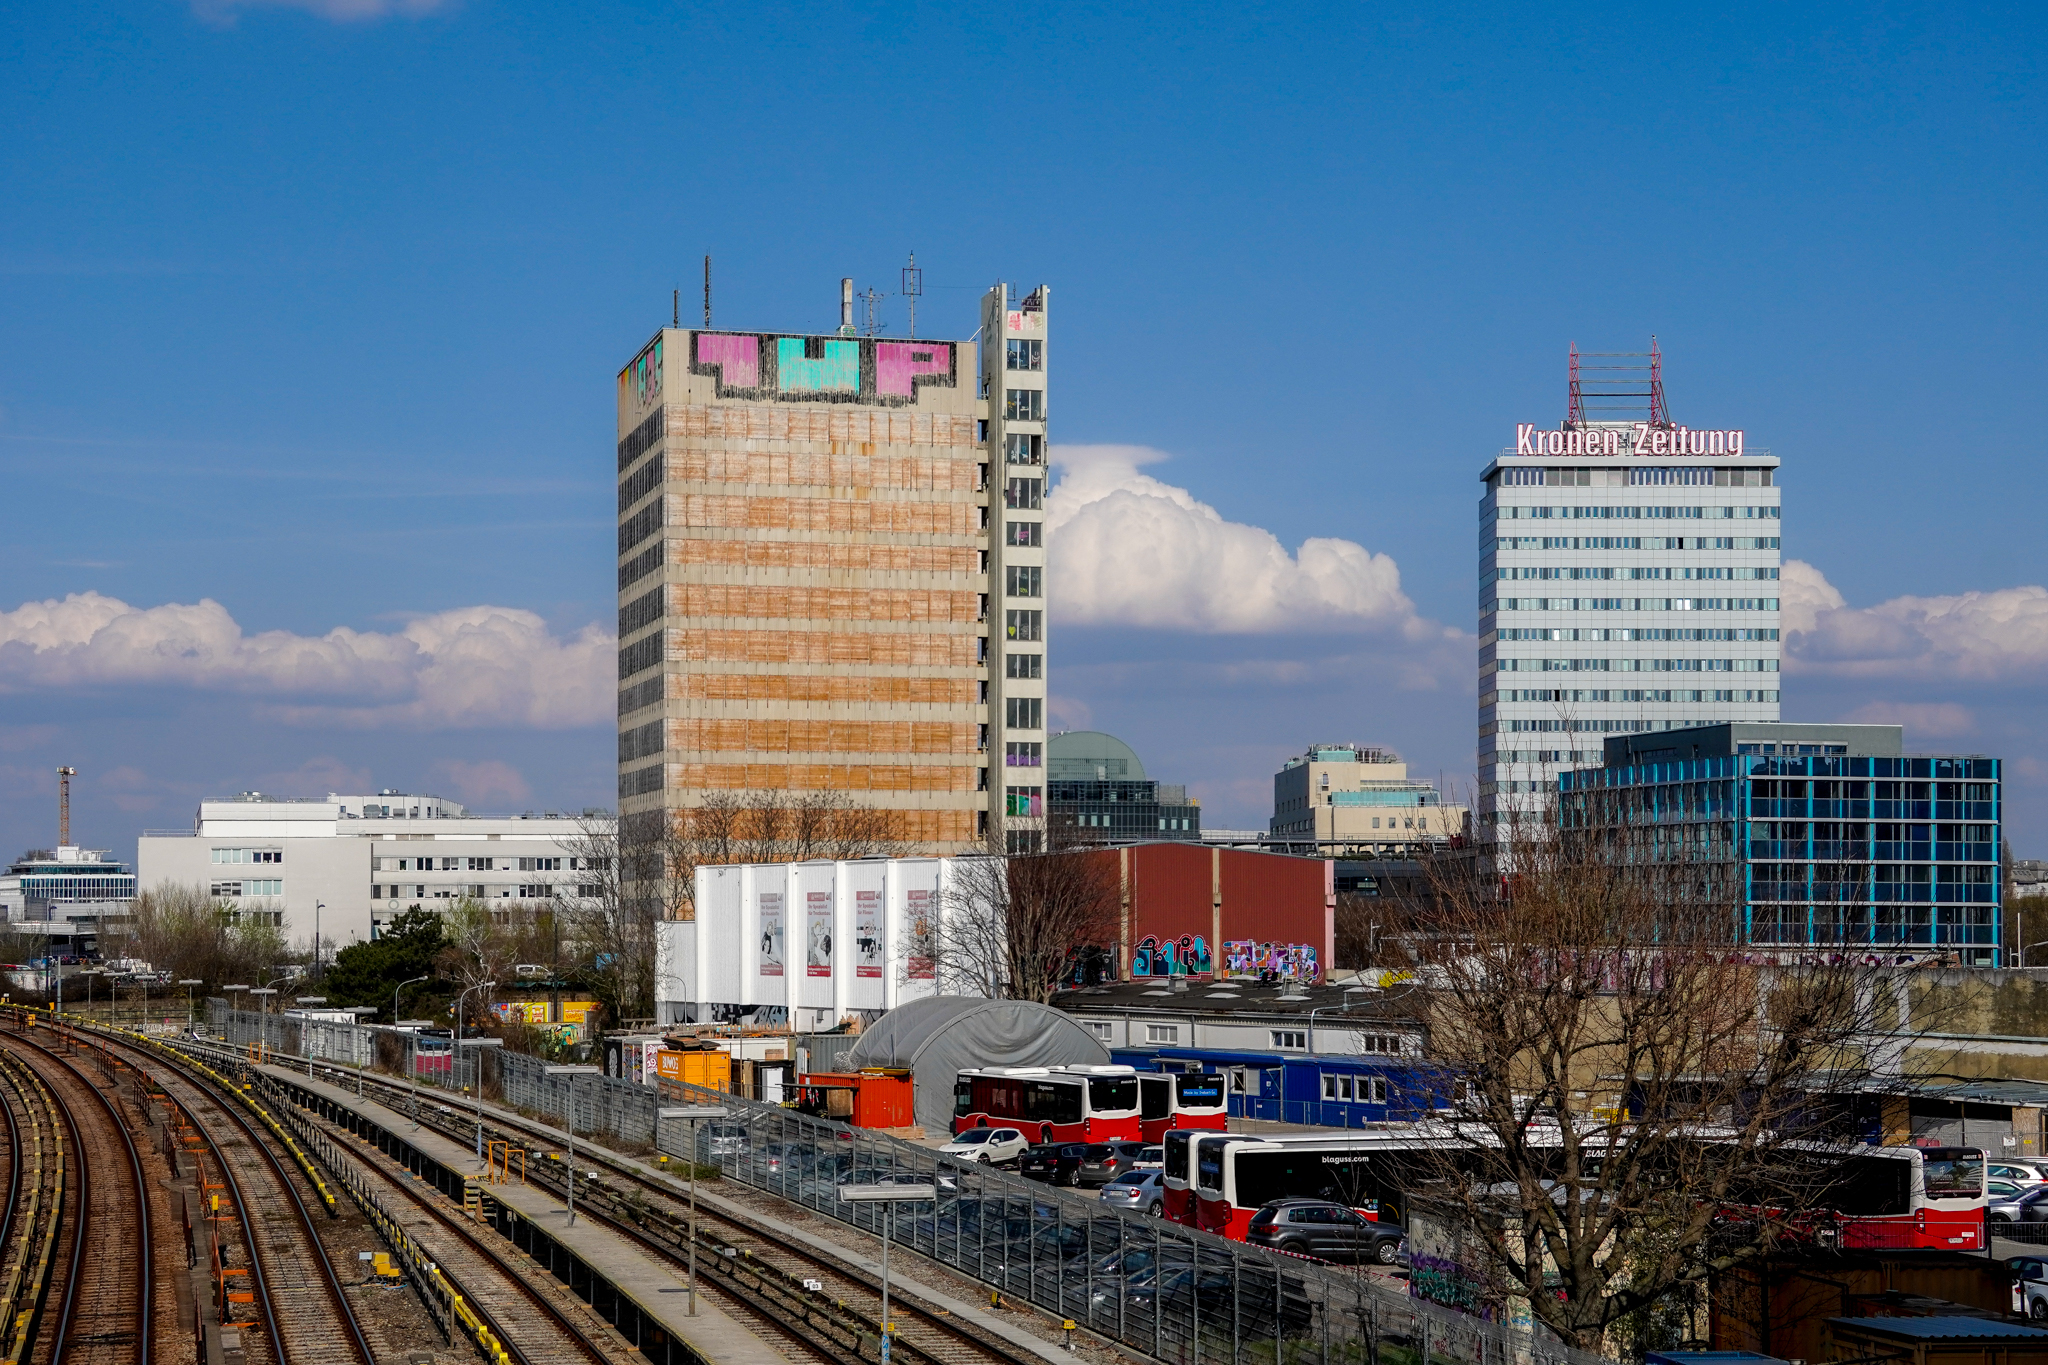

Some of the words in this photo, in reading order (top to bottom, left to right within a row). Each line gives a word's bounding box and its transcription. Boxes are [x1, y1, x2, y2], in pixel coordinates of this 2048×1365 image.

[1516, 423, 1619, 456] Kronen
[1634, 422, 1744, 457] Zeitung
[1321, 1156, 1369, 1164] blaguss.com
